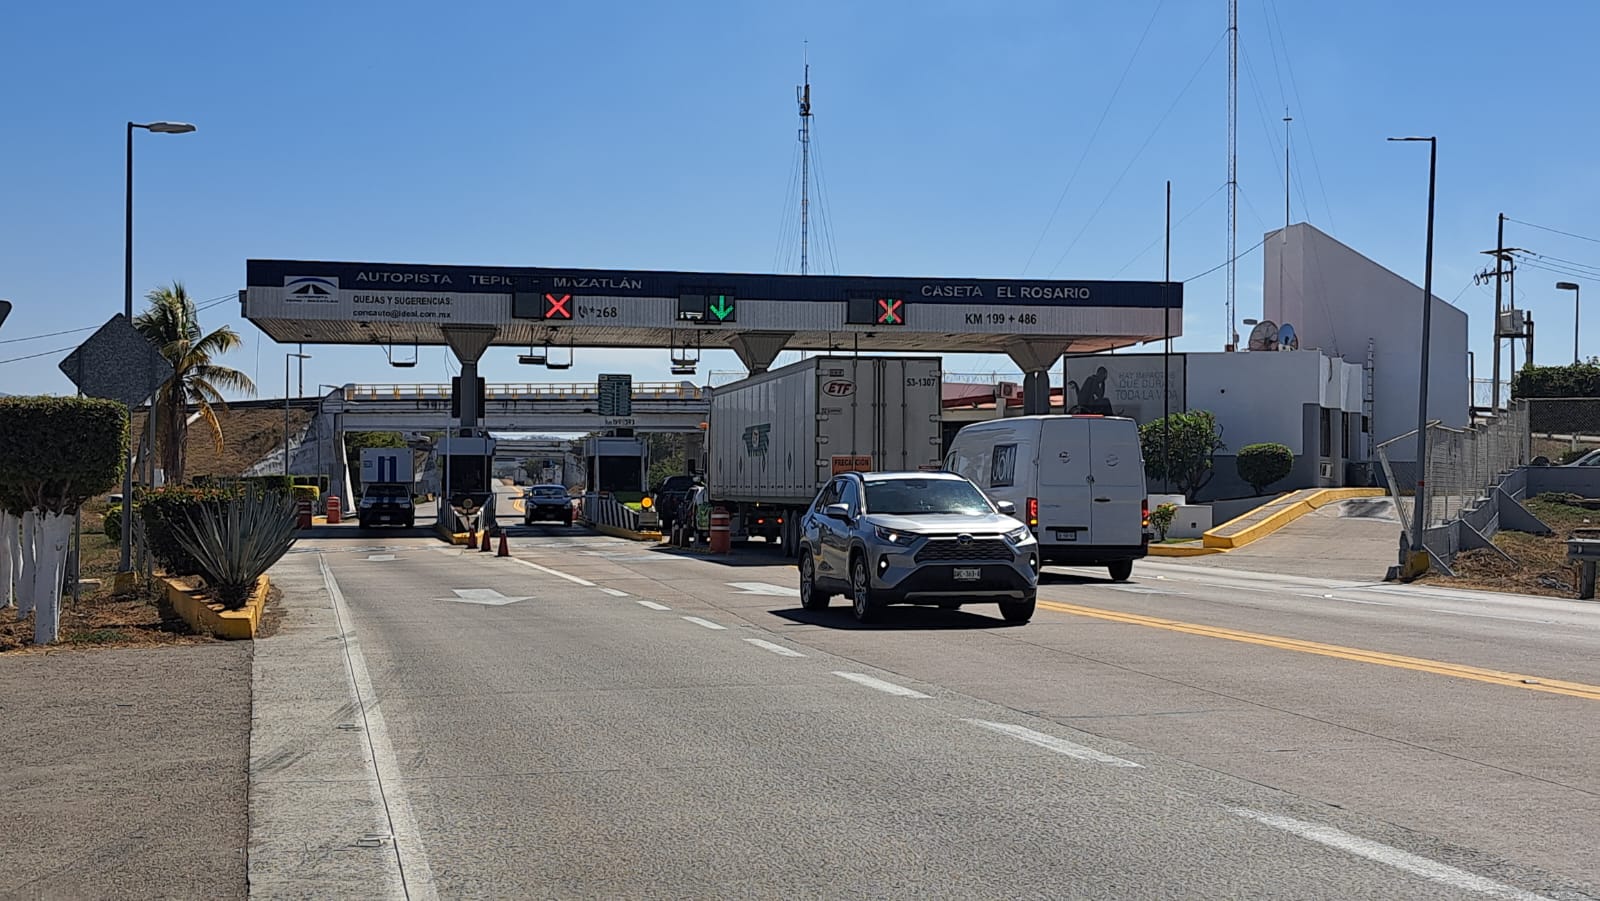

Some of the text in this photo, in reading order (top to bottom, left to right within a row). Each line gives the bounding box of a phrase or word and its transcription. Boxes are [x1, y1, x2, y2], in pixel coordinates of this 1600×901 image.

[356, 271, 453, 284] AUTOPISTA
[553, 276, 642, 289] MAZATLÁN
[921, 285, 1090, 299] CASETA EL ROSARIO
[353, 295, 453, 306] QUEJAS Y SUGERENCIAS:
[965, 313, 1037, 325] KM 199 + 486
[906, 378, 936, 387] 53-1307
[1120, 380, 1139, 389] QUE
[828, 382, 852, 395] ETF
[1116, 389, 1178, 400] TODA LA VDA
